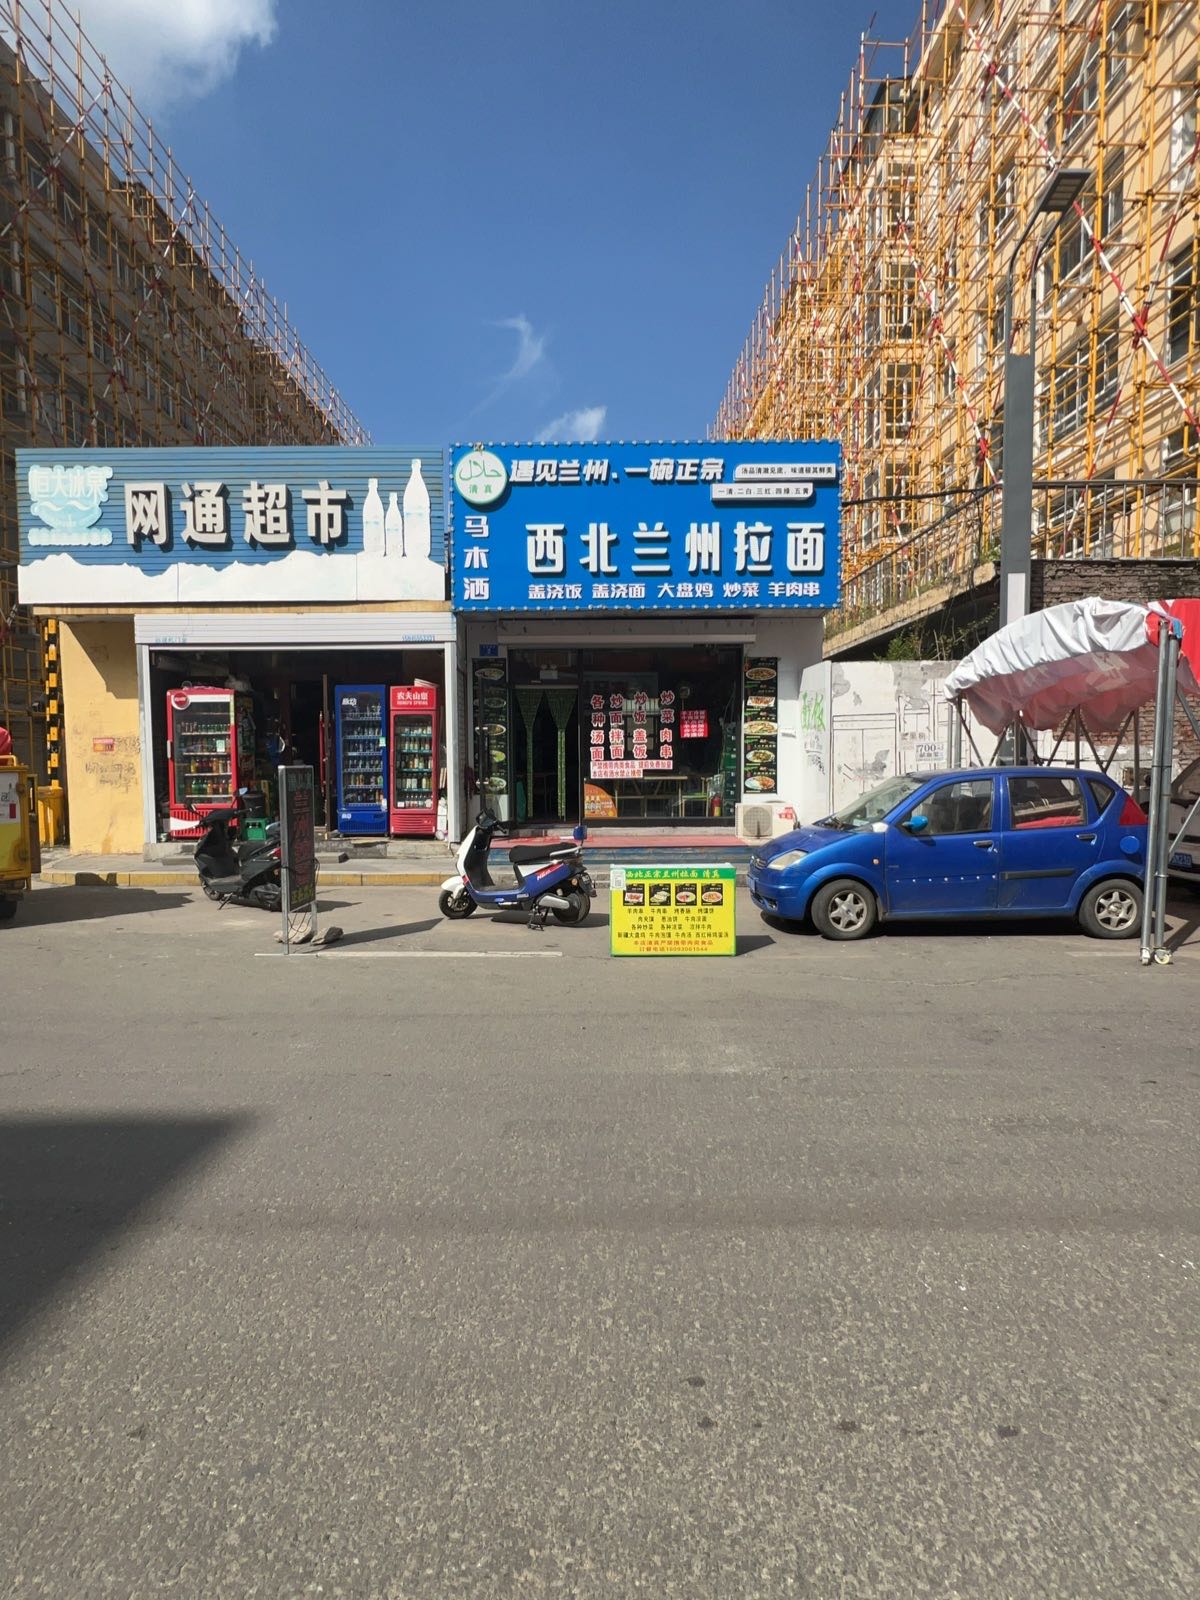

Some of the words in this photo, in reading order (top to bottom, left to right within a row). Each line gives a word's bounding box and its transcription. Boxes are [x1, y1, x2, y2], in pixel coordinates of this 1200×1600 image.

[458, 460, 502, 481] حلال
[468, 483, 493, 495] 清真
[124, 480, 350, 544] 网通超市
[525, 521, 826, 575] 西北兰州拉面
[527, 583, 582, 599] 盖浇饭
[591, 582, 646, 599] 盖浇面
[657, 582, 714, 598] 大盘鸡
[722, 582, 760, 598] 炒菜
[767, 582, 821, 598] 羊肉串
[397, 692, 429, 700] 农夫山泉
[590, 694, 605, 761] 各种汤面
[609, 693, 625, 759] 炒面拌面
[632, 691, 648, 759] 炒饭盖饭
[660, 690, 675, 759] 炒菜肉串
[626, 870, 698, 878] 西北正宗兰州拉面
[703, 869, 719, 878] 清真
